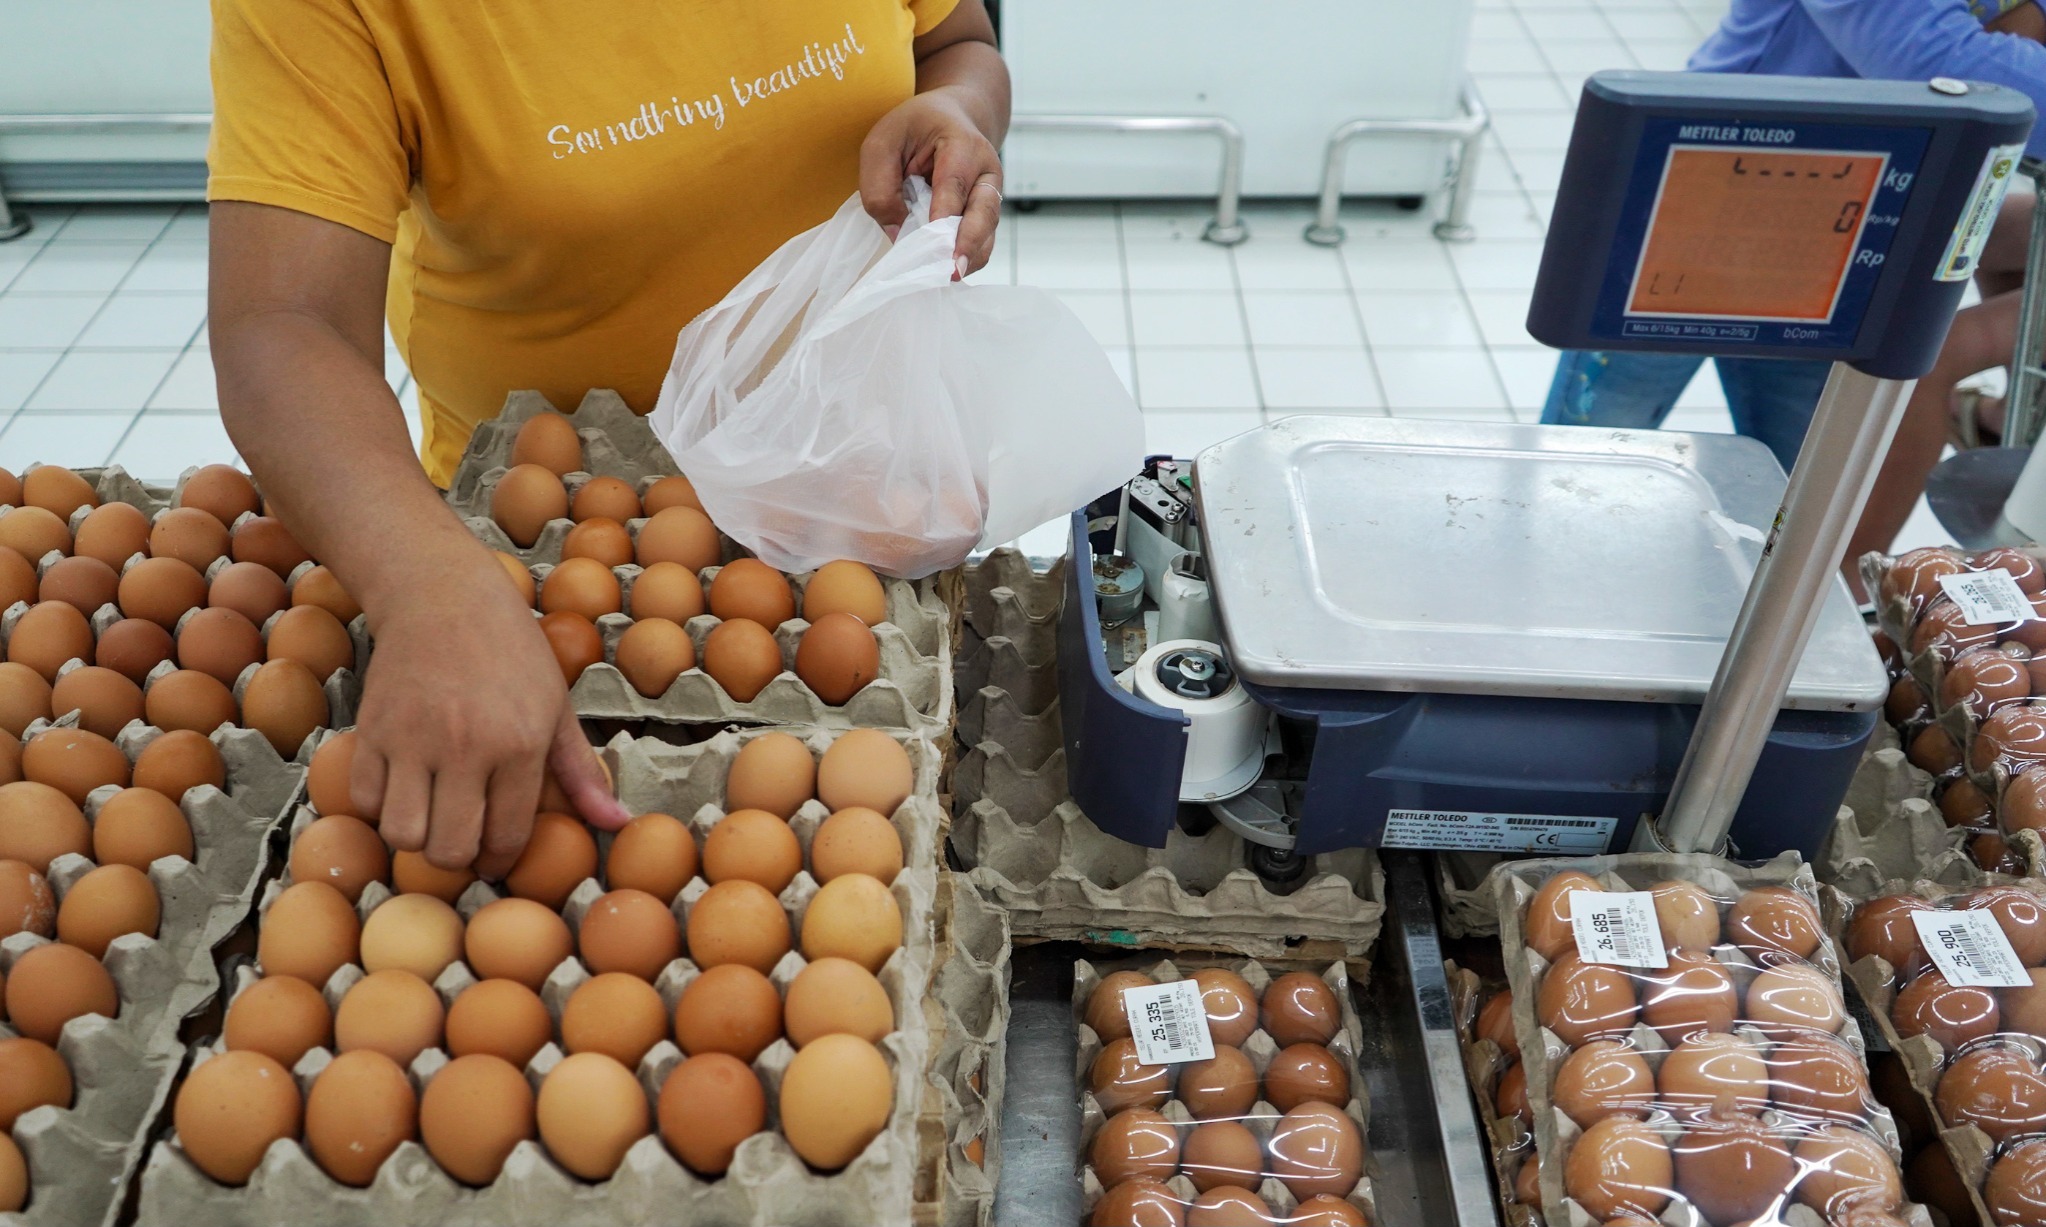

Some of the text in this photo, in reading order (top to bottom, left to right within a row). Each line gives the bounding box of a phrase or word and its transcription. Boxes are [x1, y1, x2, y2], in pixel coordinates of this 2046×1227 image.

[730, 23, 865, 107] beautiful
[1678, 125, 1796, 143] METTLER TOLEDO
[1884, 167, 1913, 192] kg
[1833, 202, 1863, 233] 0
[1855, 249, 1885, 268] Rp
[1783, 327, 1819, 339] bCom
[1391, 812, 1468, 823] METTLER TOLEDO
[1592, 913, 1613, 950] 26.685
[1937, 930, 1971, 967] 25.900
[1146, 1002, 1166, 1041] 25.335
